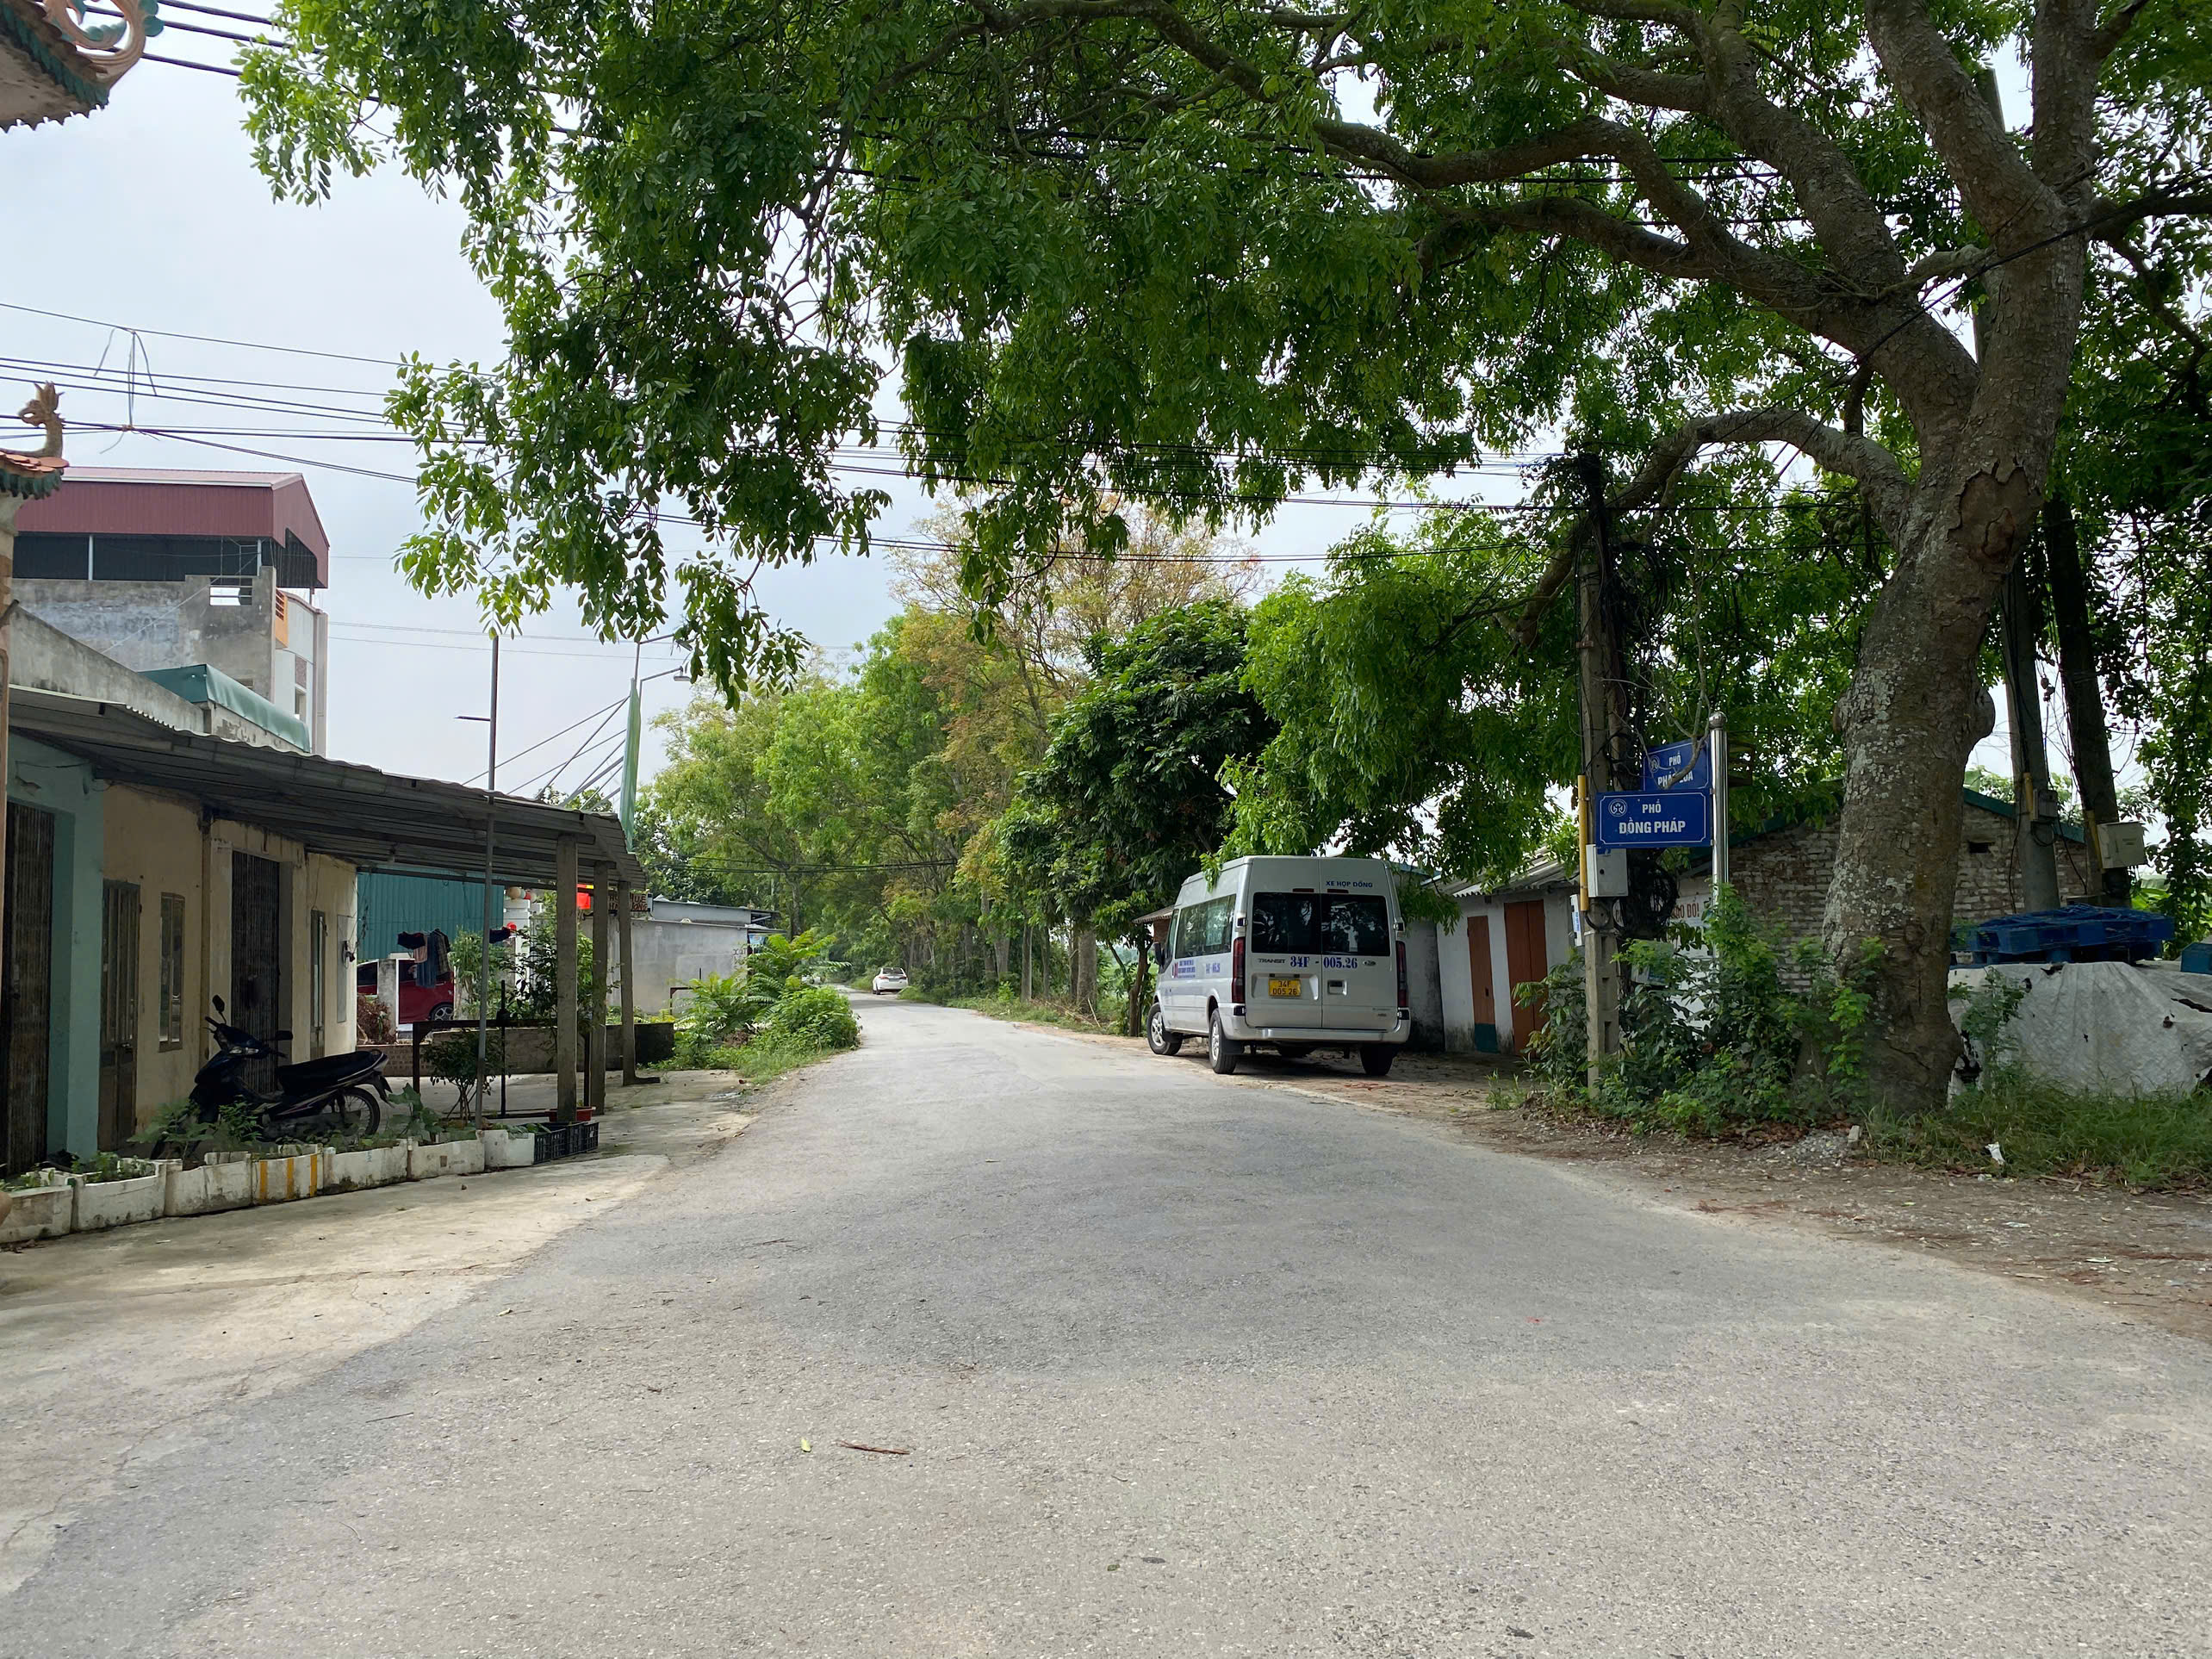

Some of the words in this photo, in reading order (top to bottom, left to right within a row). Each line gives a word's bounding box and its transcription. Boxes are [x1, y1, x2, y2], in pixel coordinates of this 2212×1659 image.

[1657, 771, 1675, 787] PHÁ
[1642, 798, 1662, 814] PHỐ
[1619, 817, 1652, 835] ĐỒNG
[1654, 817, 1686, 834] PHÁP
[1289, 955, 1310, 968] 34F
[1323, 956, 1358, 969] 005.26
